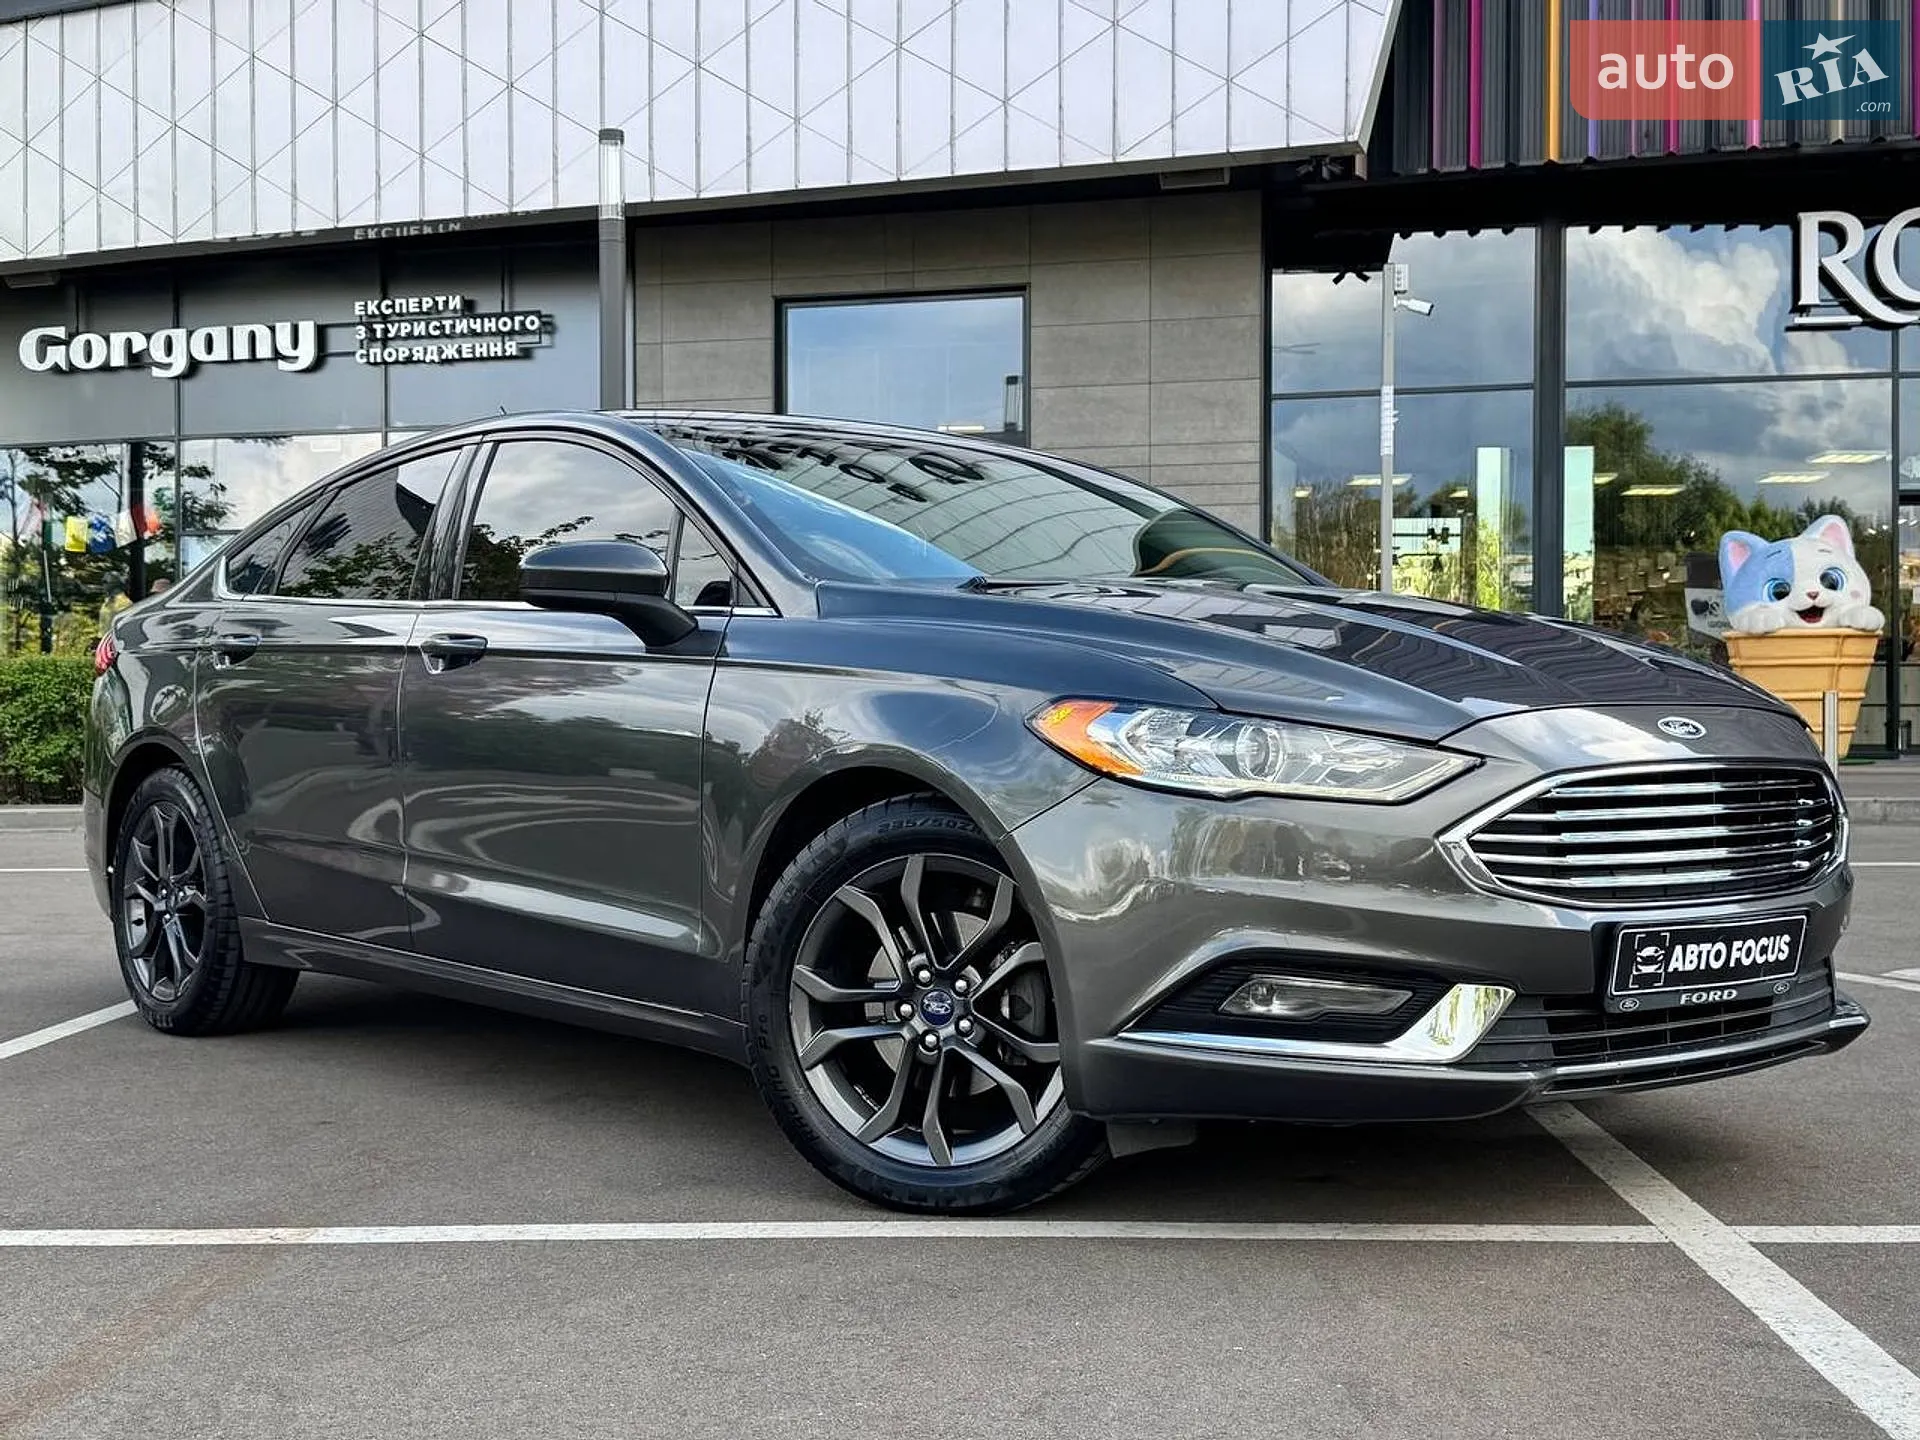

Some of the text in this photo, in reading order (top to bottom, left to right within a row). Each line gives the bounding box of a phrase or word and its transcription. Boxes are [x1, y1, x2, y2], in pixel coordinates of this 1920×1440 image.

[354, 295, 461, 316] ЕКСПЕРТИ
[373, 314, 540, 340] ТУРИСТИЧНОГО
[19, 320, 317, 378] Gorgany
[355, 340, 518, 364] СПОРЯДЖЕННЯ
[1730, 934, 1791, 968] FOCUS
[1679, 988, 1738, 1005] FORD
